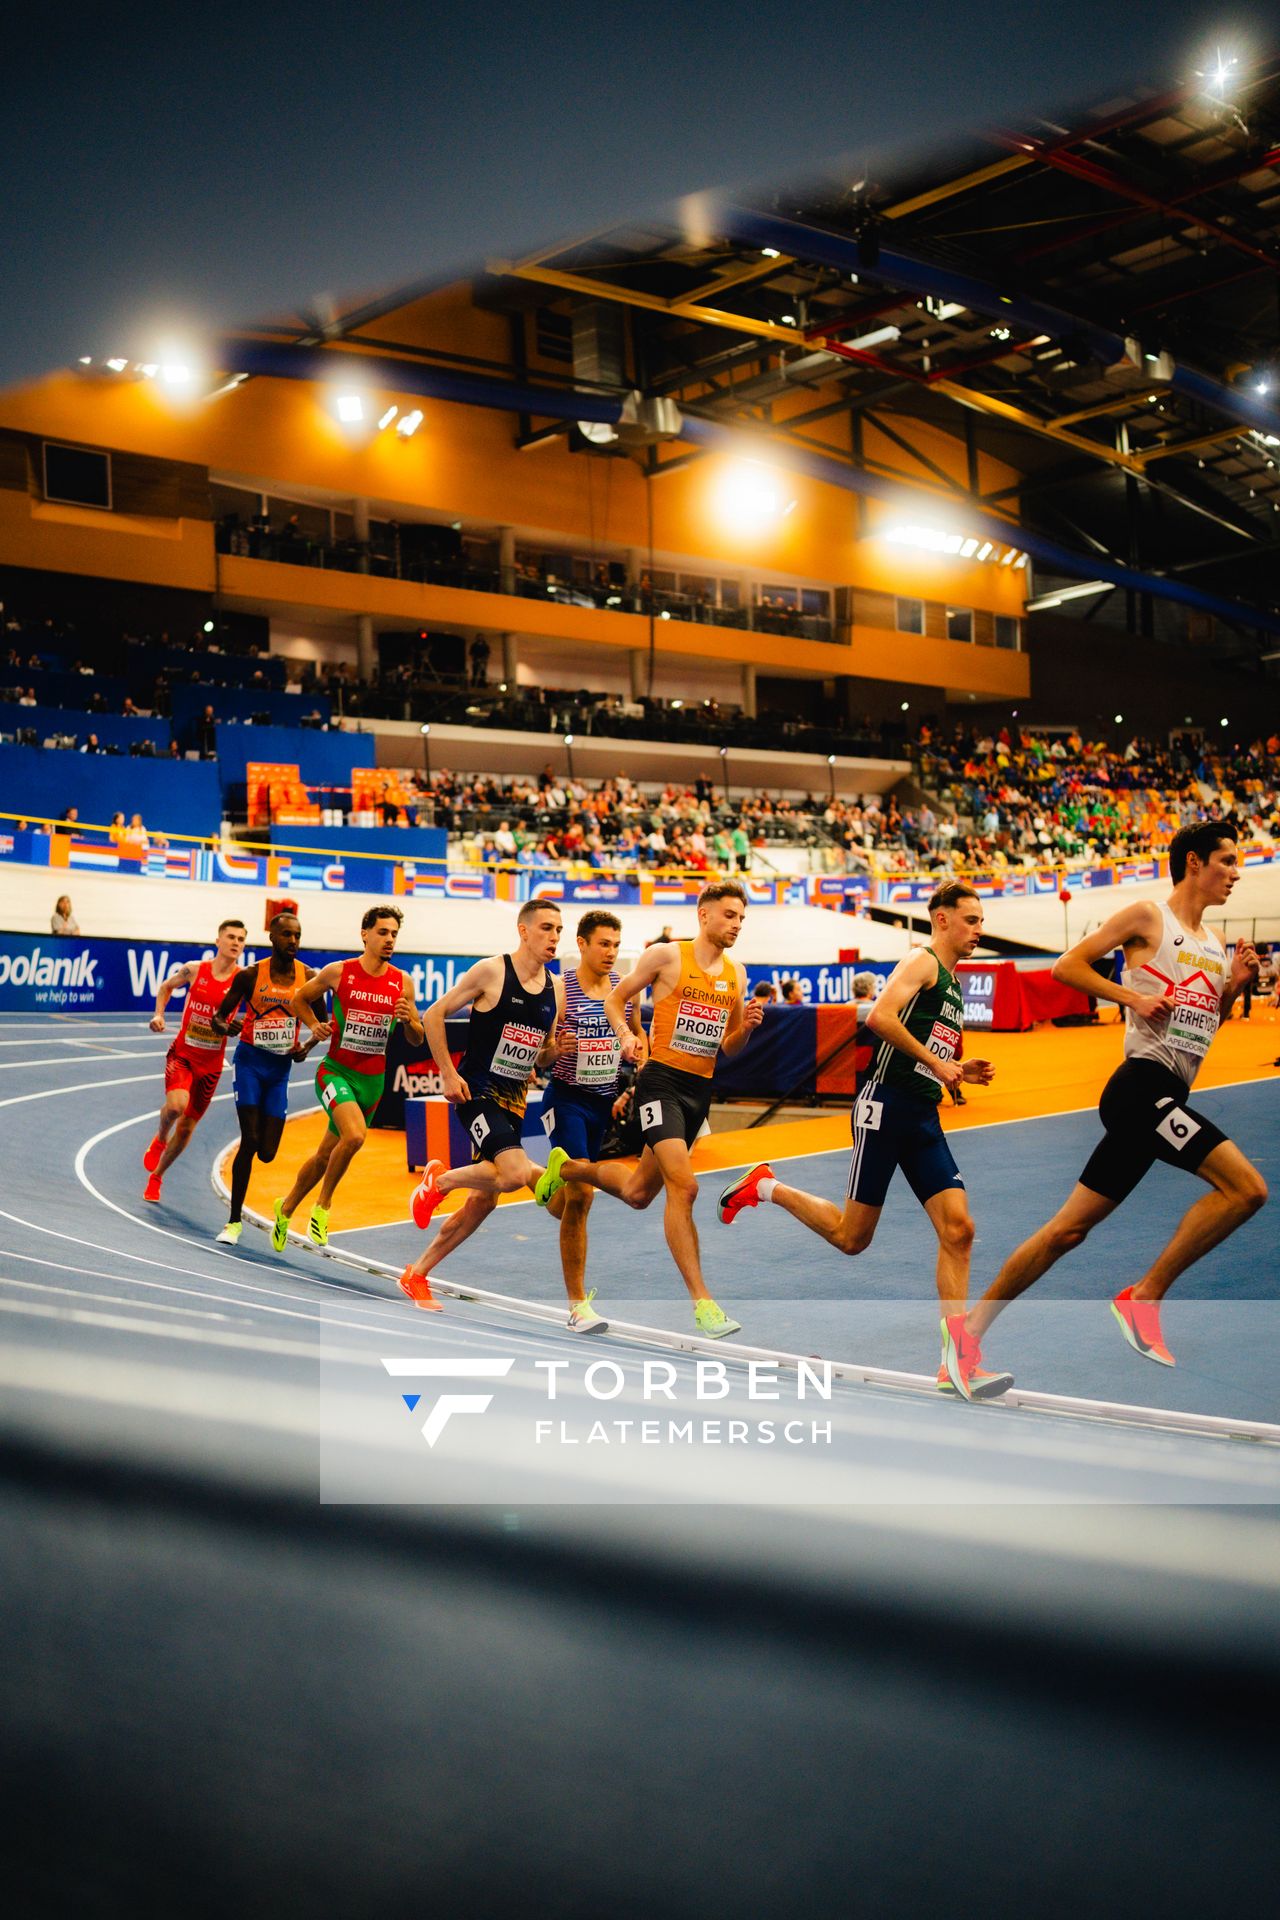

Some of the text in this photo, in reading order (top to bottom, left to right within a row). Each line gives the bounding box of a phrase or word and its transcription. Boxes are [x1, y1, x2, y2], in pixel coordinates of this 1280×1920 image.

[1176, 950, 1223, 976] BELGIUM
[127, 949, 187, 998] We
[968, 975, 993, 996] 21.0
[35, 990, 94, 1005] we help to win
[349, 990, 393, 1006] PORTUGAL
[682, 986, 736, 1006] GERMANY
[1175, 989, 1217, 1013] SPAR
[348, 1011, 382, 1024] SPAR
[681, 1003, 719, 1021] SPAR
[255, 1020, 285, 1029] SPAR
[578, 1017, 607, 1026] GRE
[676, 1017, 724, 1039] PROBST
[254, 1031, 279, 1041] ABDI
[345, 1023, 388, 1039] PEREIRA
[503, 1028, 541, 1047] SPAR
[577, 1027, 616, 1037] BRITA
[580, 1041, 612, 1051] SPAR
[930, 1041, 953, 1063] DOY
[587, 1055, 614, 1066] KEEN
[392, 1064, 446, 1098] Apeld
[325, 1090, 331, 1100] 1
[645, 1107, 654, 1125] 3
[863, 1105, 874, 1125] 2
[474, 1122, 483, 1139] 8
[1169, 1117, 1188, 1138] 6
